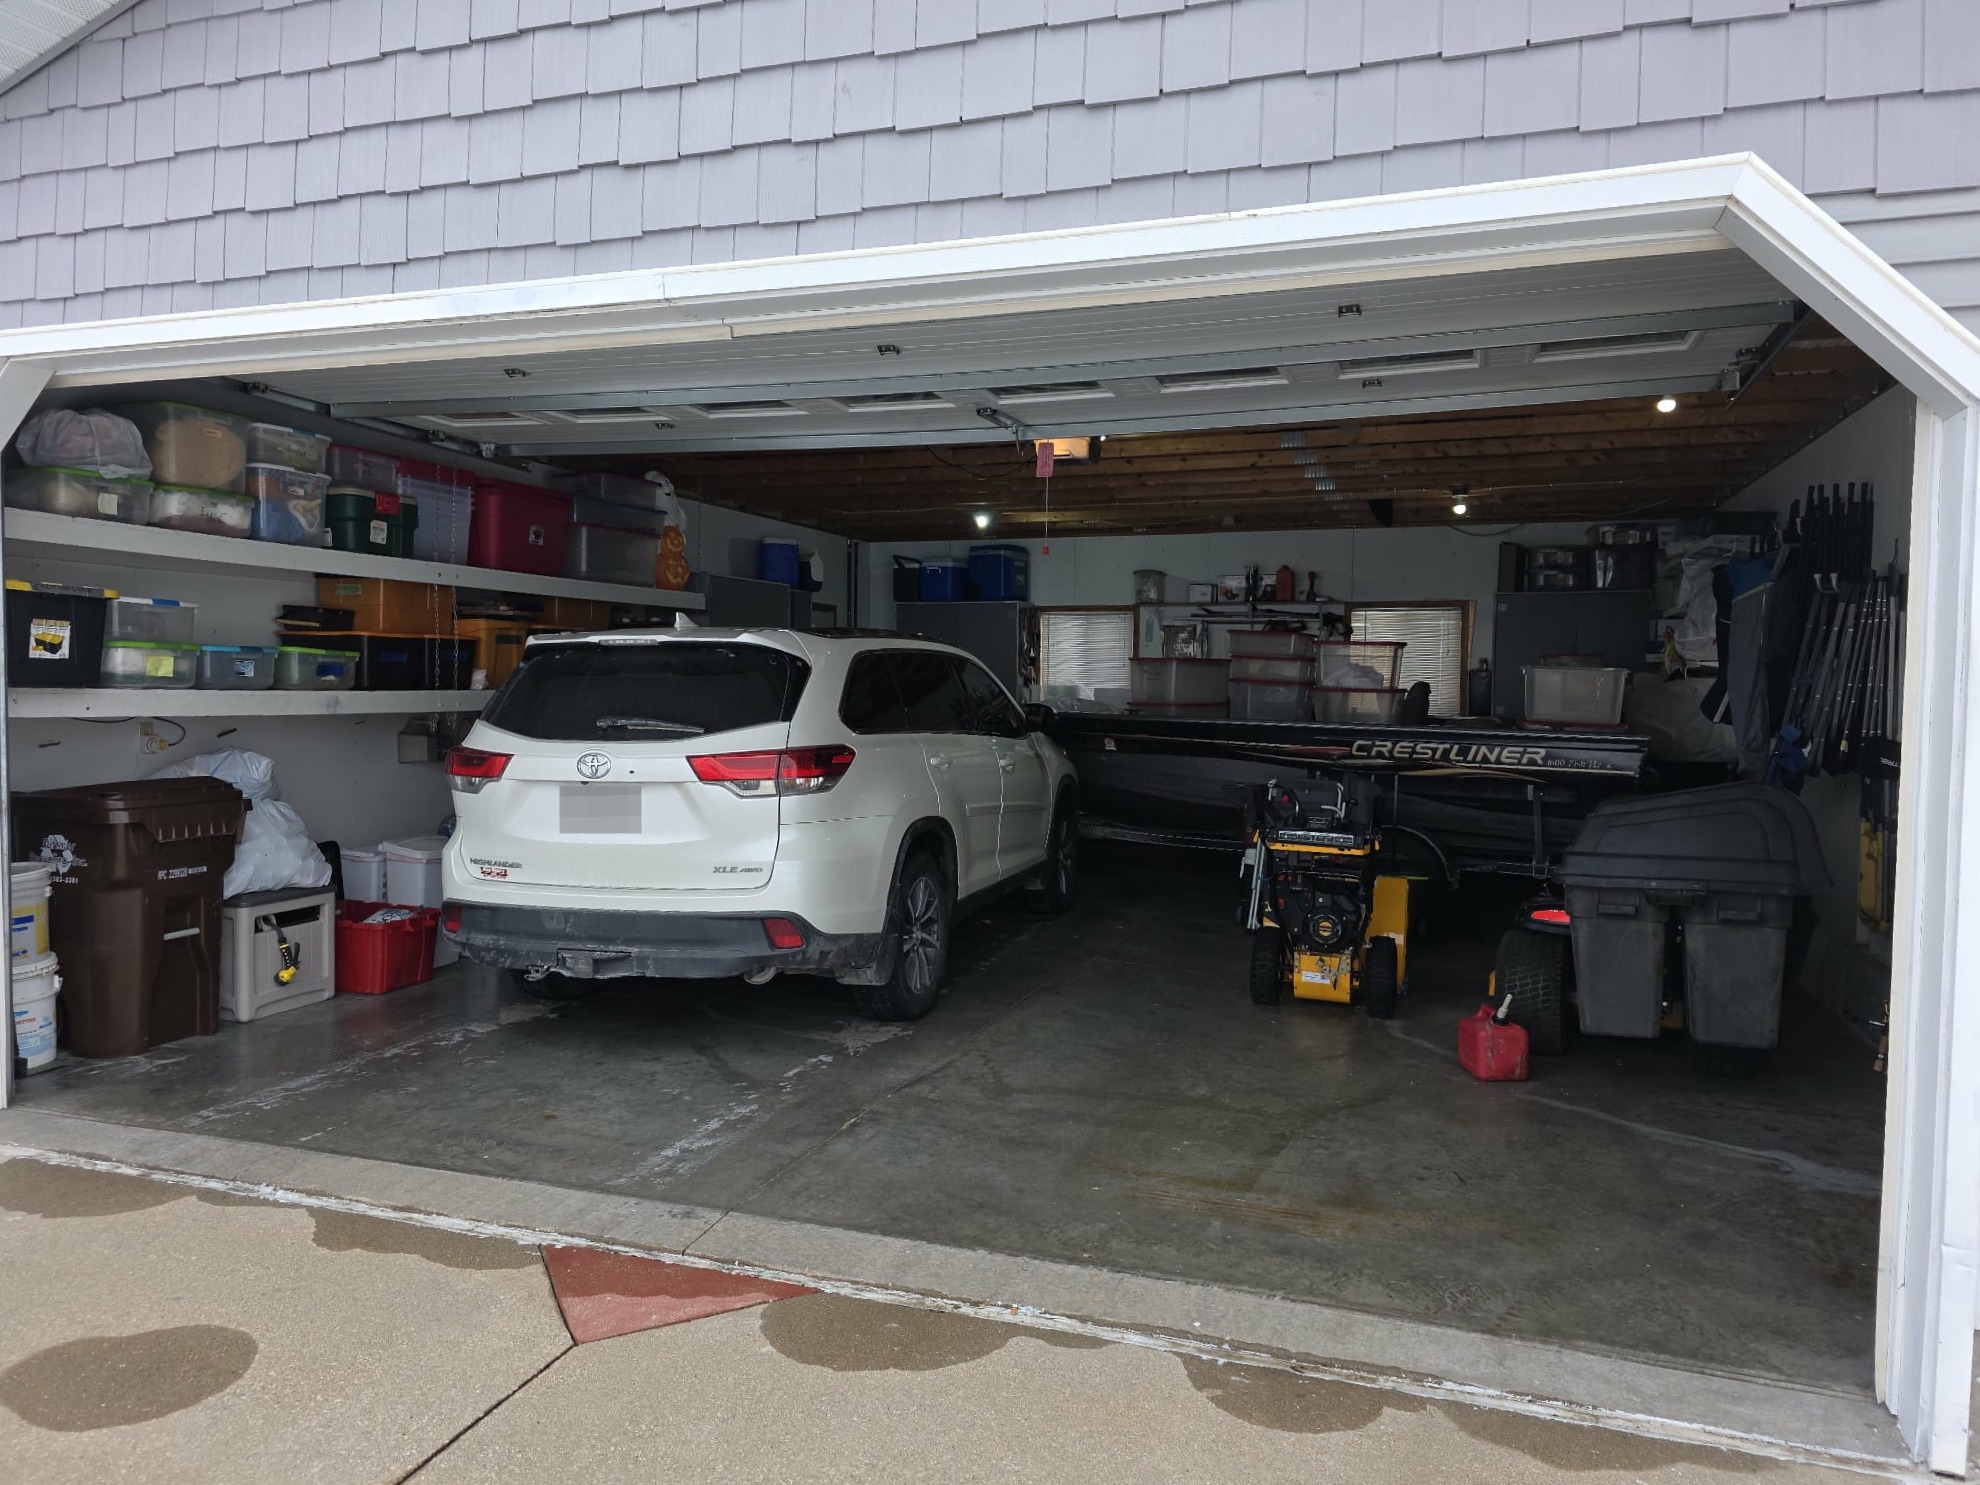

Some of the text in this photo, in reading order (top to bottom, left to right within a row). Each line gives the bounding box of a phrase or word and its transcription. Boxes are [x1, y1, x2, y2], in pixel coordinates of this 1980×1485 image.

[1351, 740, 1547, 764] CRESTLINER
[469, 857, 523, 868] HIGHLANDER
[712, 866, 739, 874] XLE
